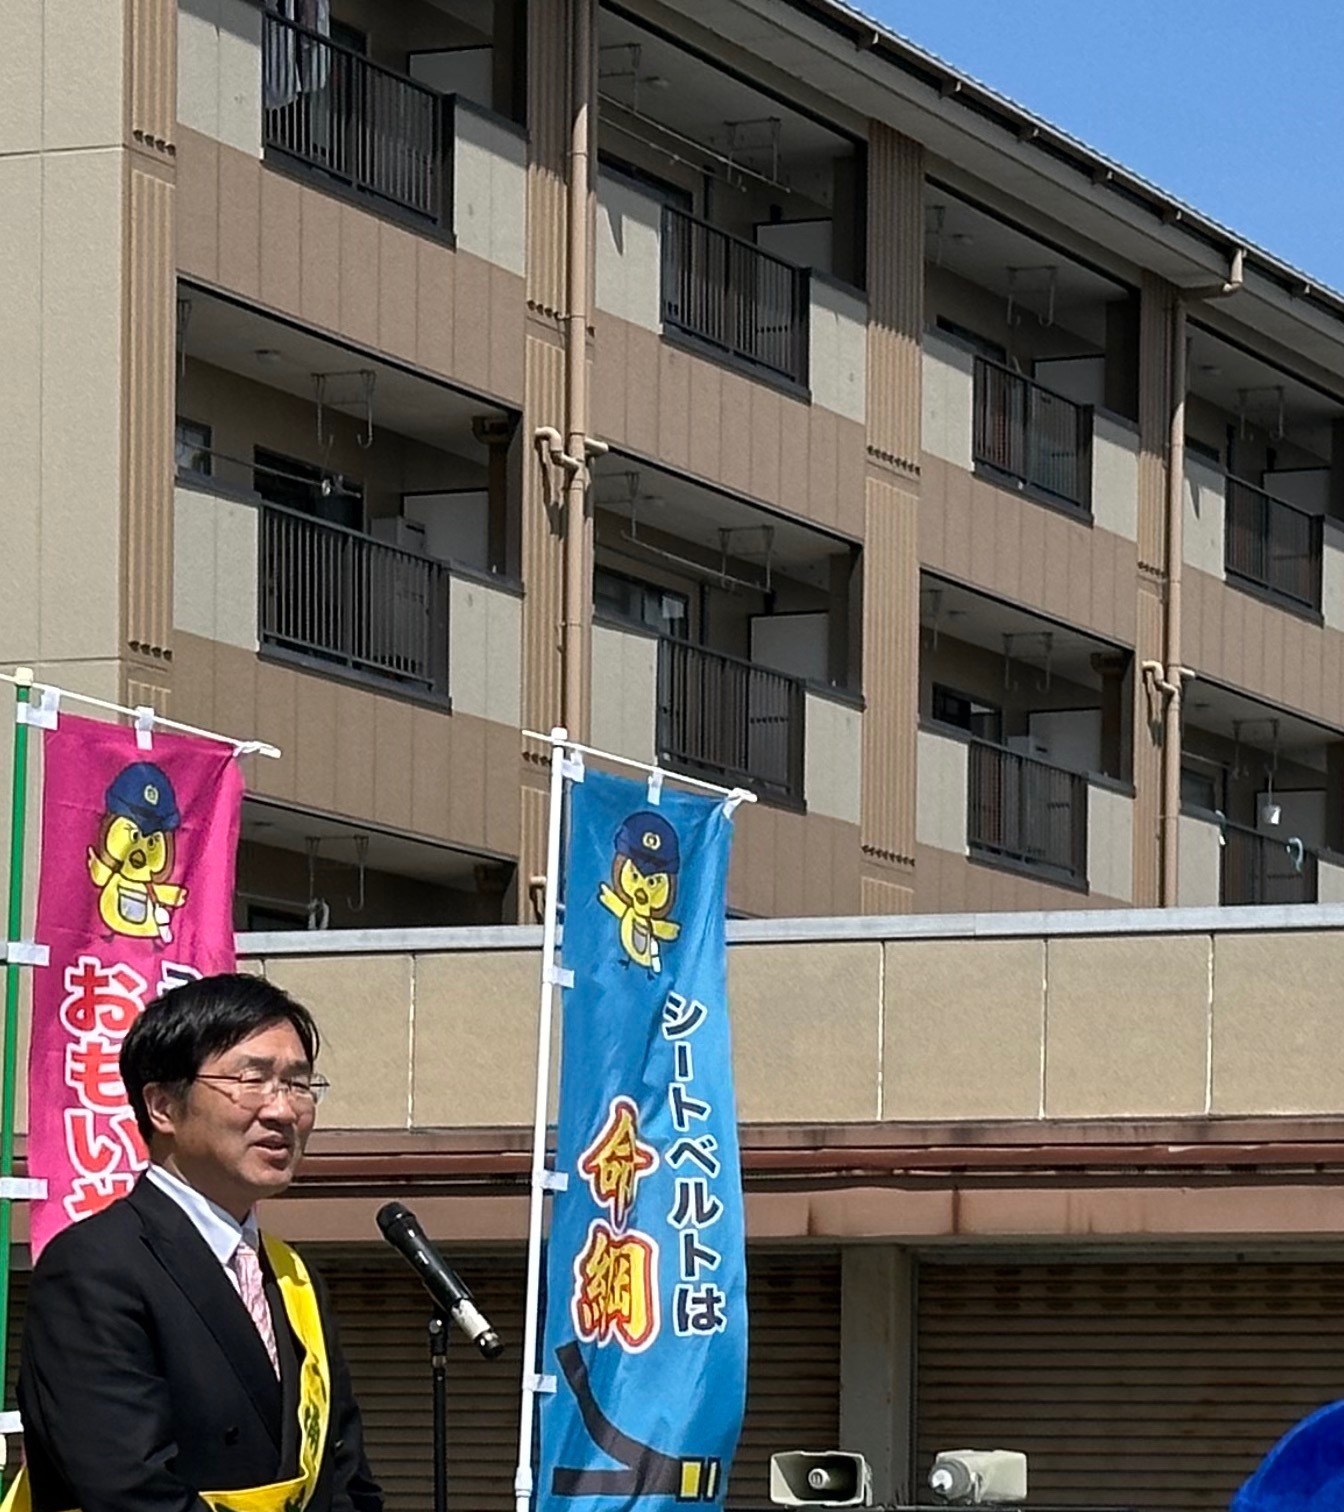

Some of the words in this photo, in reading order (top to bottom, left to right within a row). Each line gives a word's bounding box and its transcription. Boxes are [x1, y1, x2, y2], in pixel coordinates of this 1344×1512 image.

[570, 1096, 659, 1354] 命綱
[661, 987, 727, 1337] シートベルトは
